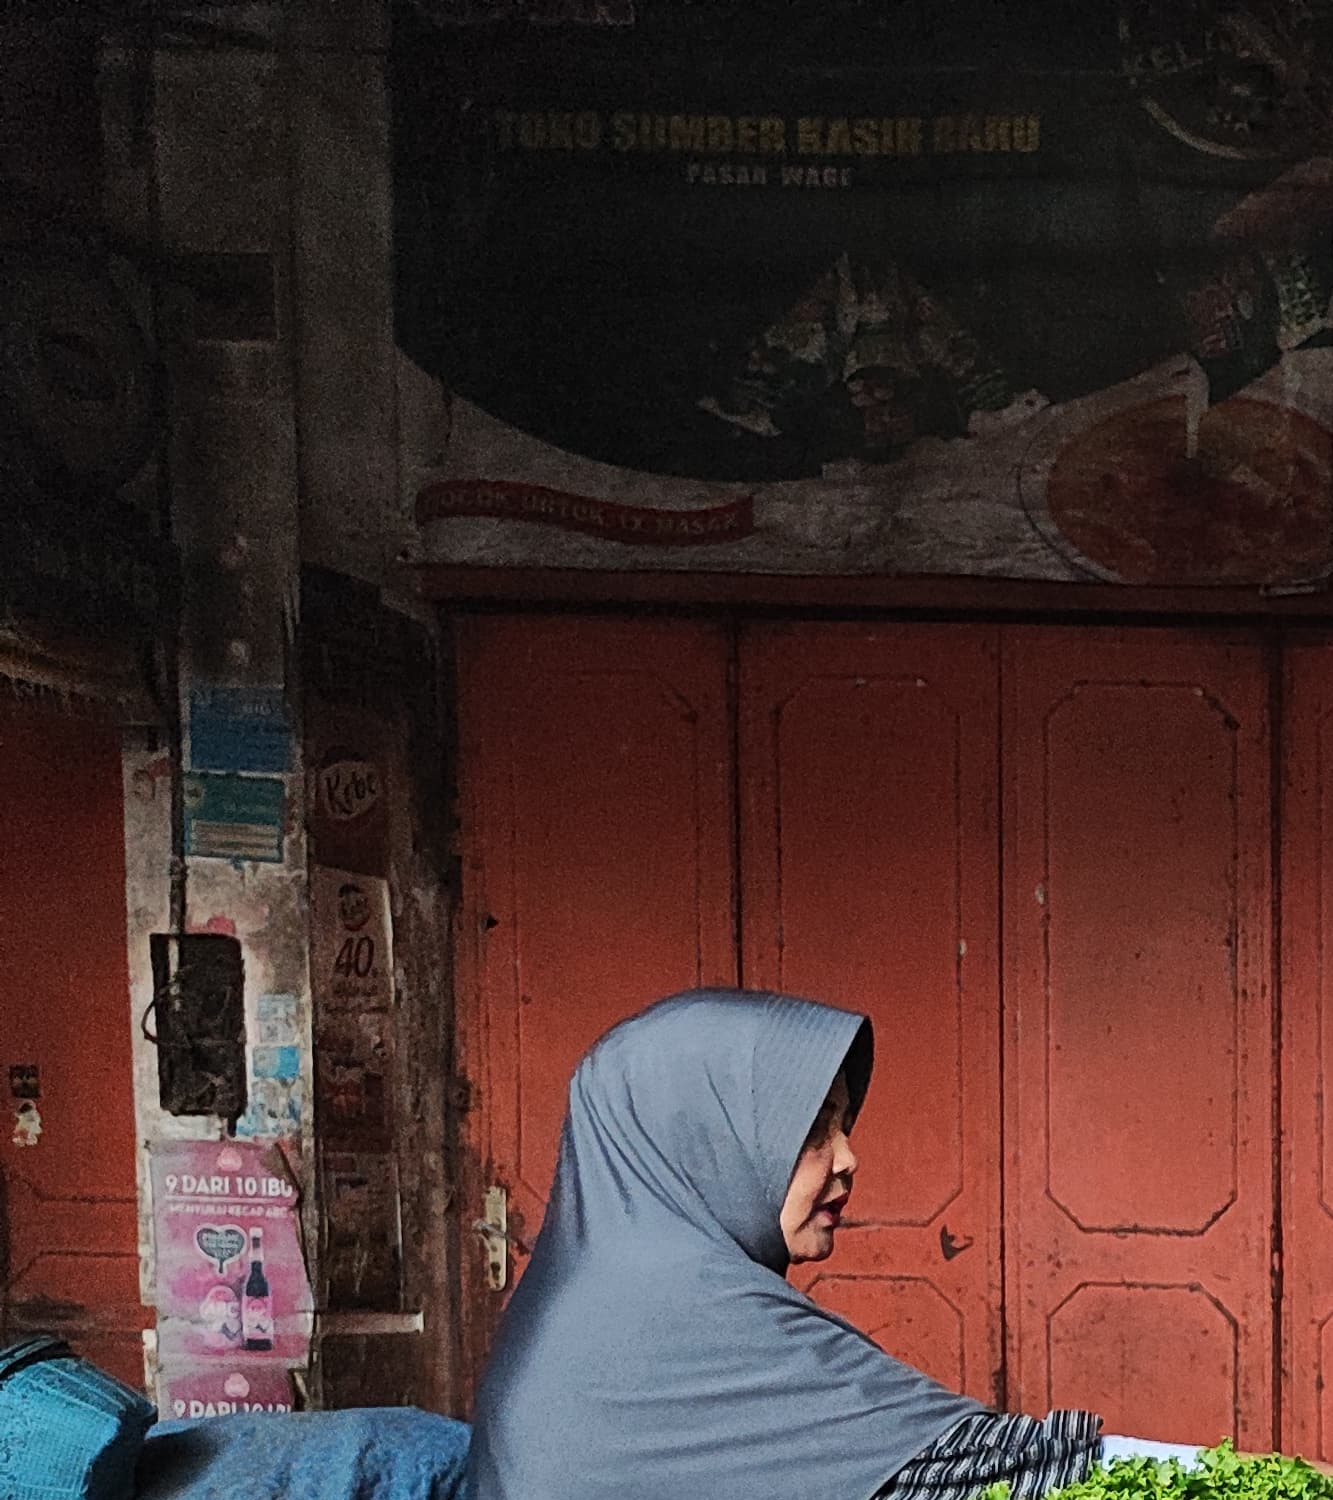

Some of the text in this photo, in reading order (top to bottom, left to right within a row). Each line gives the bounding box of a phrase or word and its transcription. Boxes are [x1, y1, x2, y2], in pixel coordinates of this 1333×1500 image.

[495, 109, 602, 153] TOKO
[610, 111, 787, 156] SUMBER
[165, 1174, 178, 1195] 9
[181, 1175, 230, 1197] DARI
[235, 1177, 258, 1197] 10
